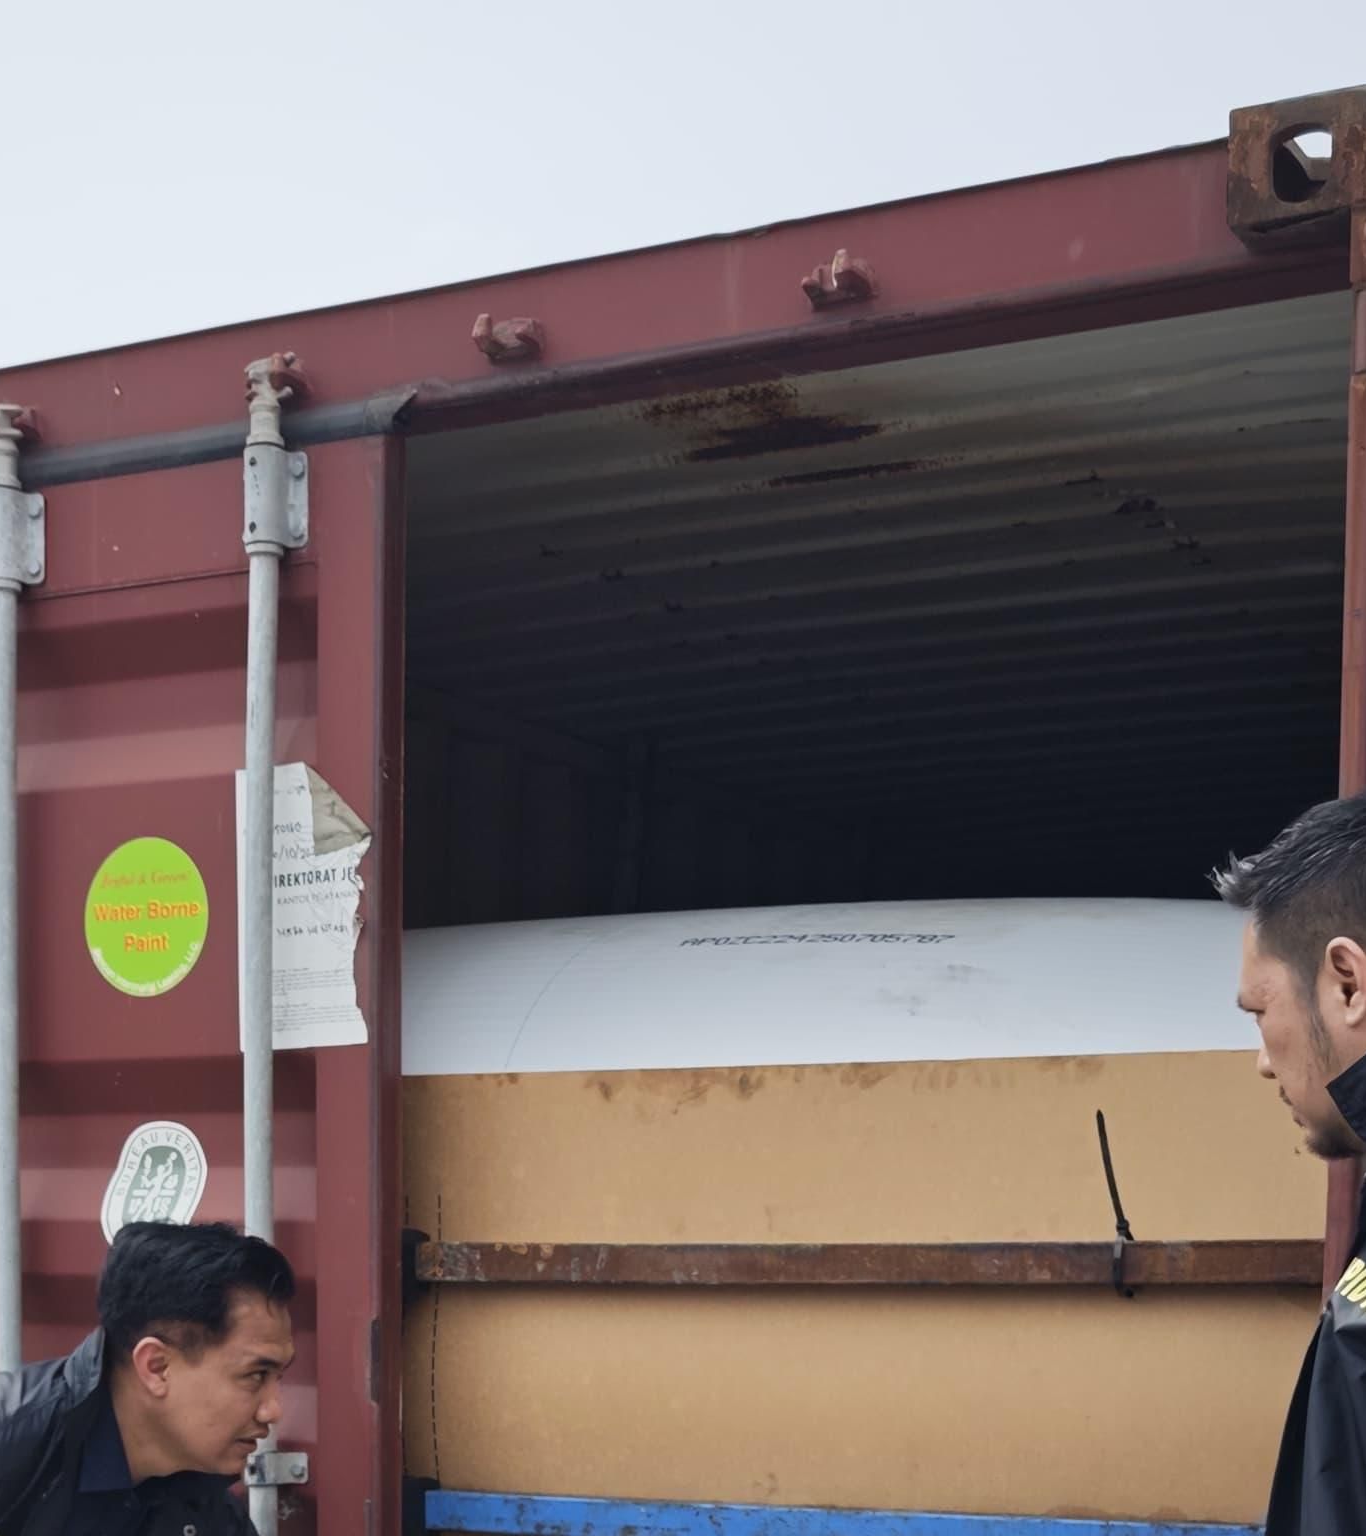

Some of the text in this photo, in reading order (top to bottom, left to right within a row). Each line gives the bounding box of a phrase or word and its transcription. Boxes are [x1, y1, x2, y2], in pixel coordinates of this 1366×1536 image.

[274, 868, 336, 888] IREKTORAT
[93, 900, 200, 922] Water Borne
[124, 932, 169, 953] Paint
